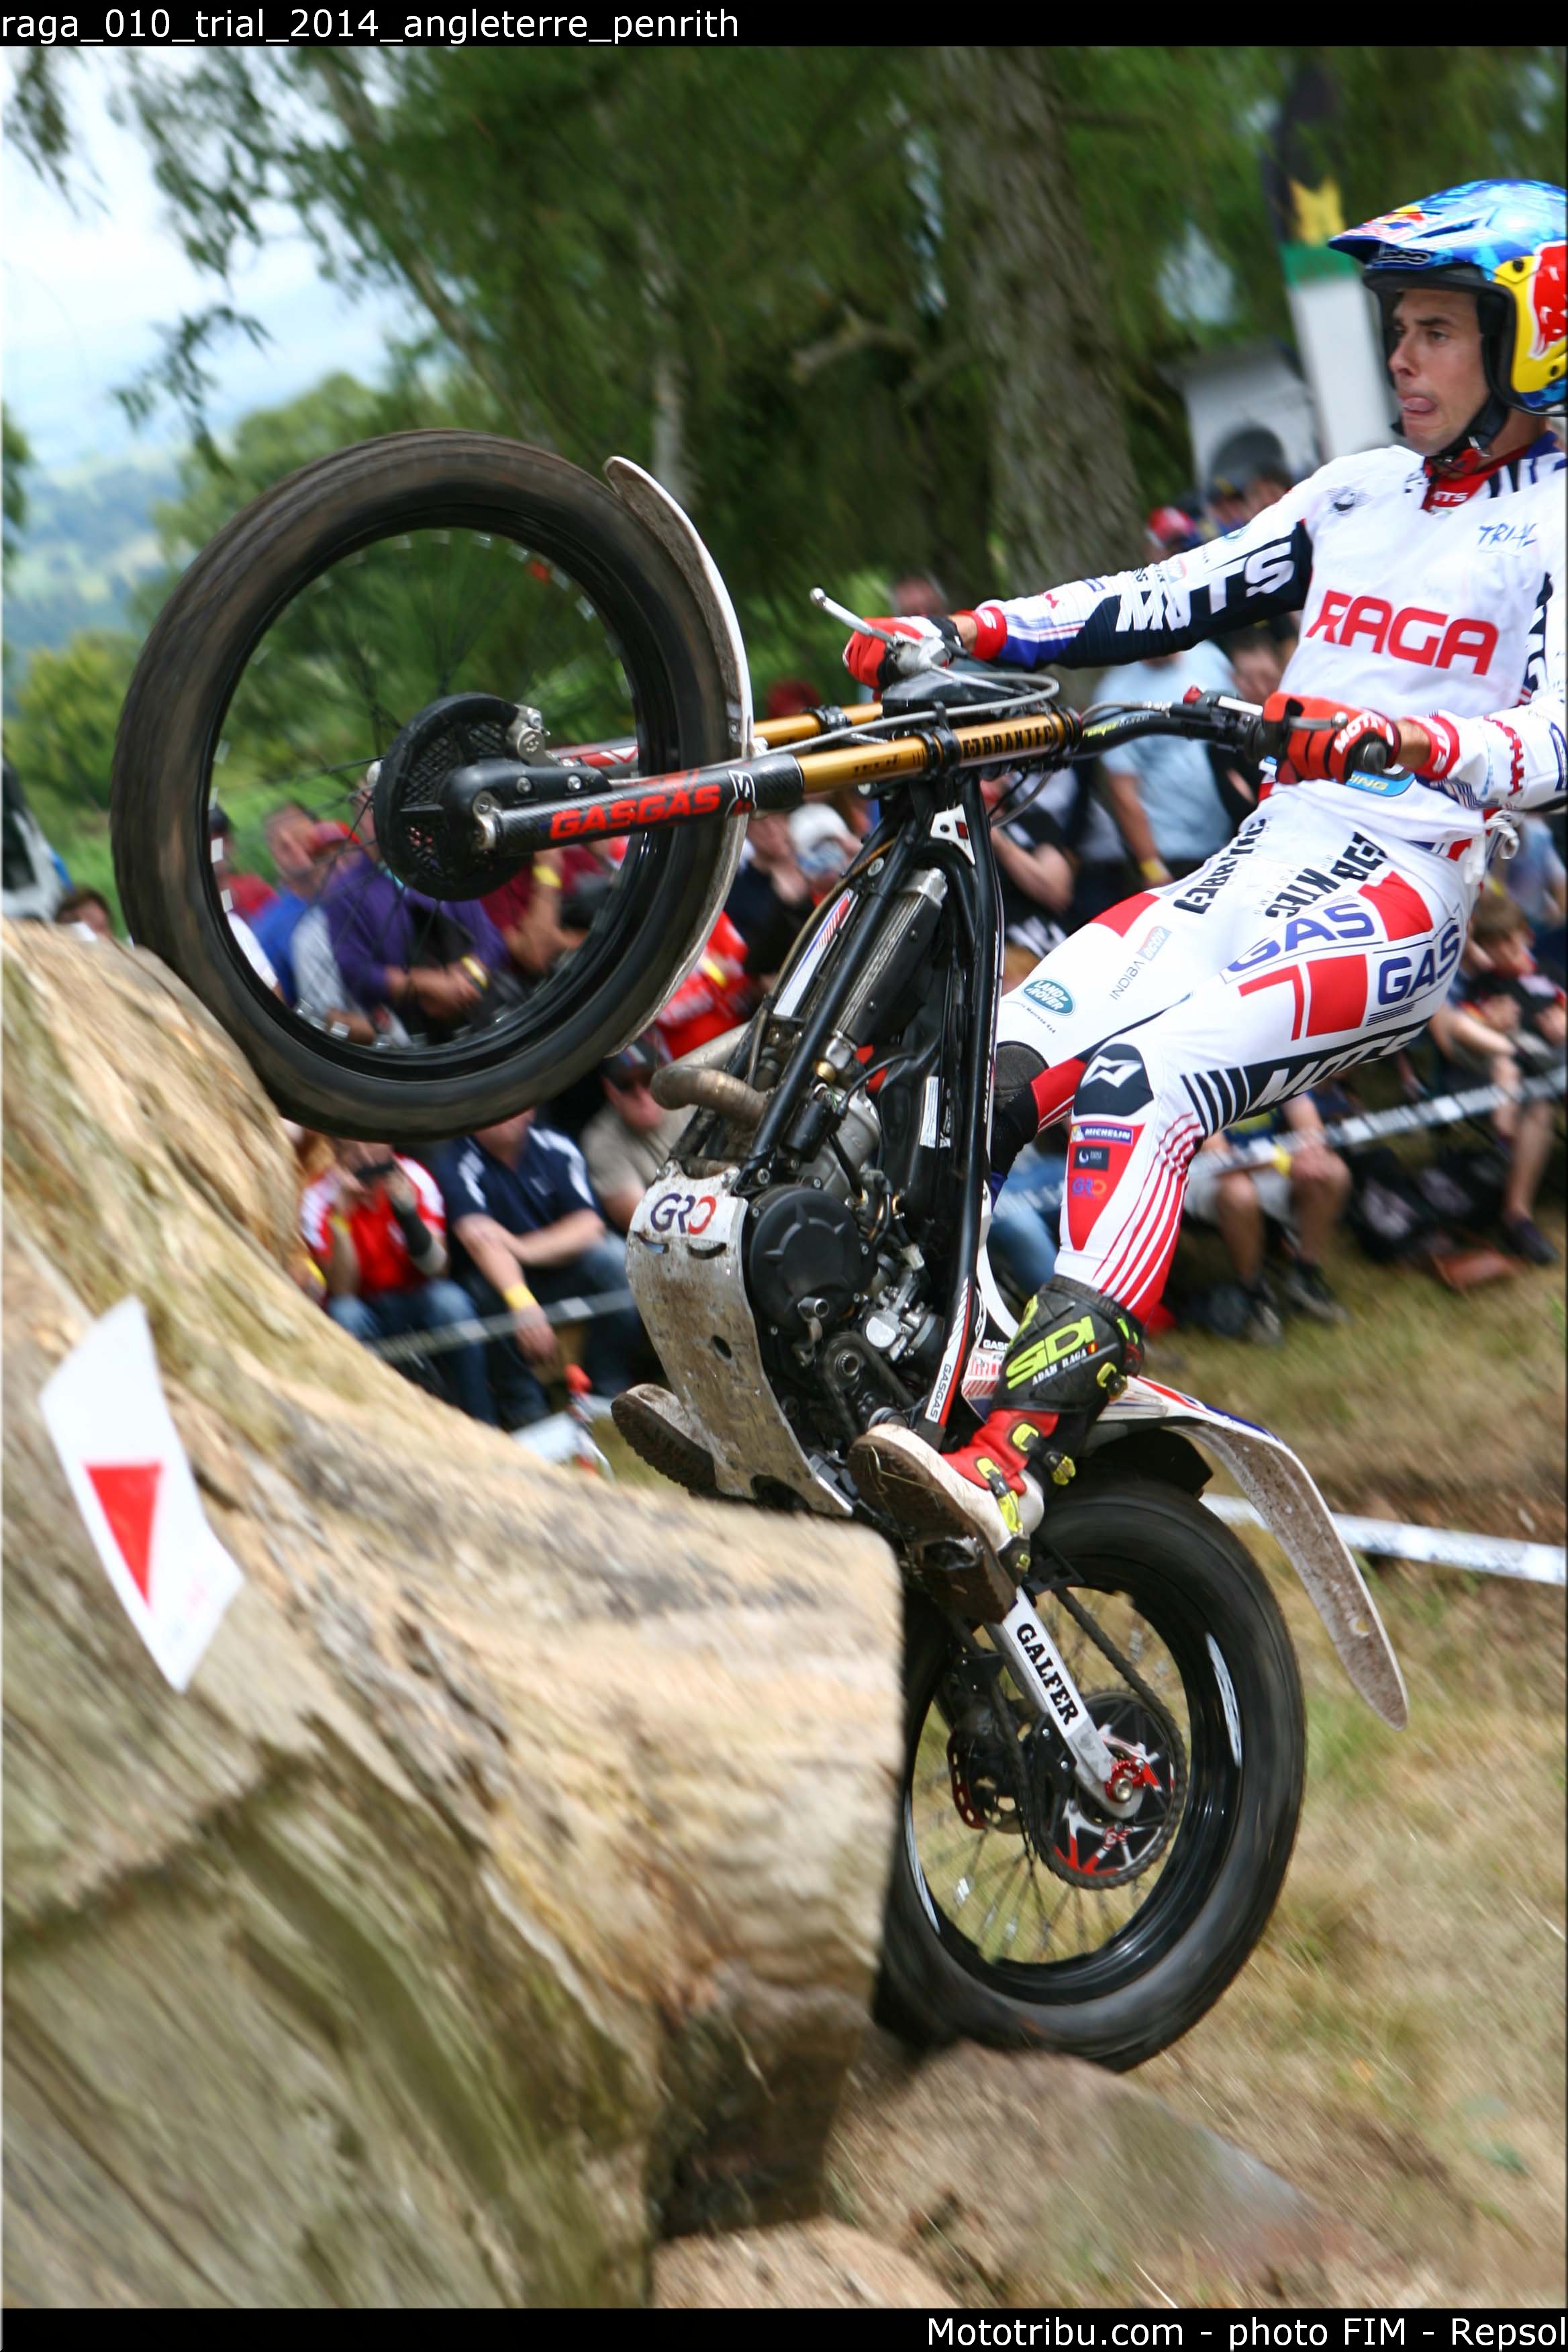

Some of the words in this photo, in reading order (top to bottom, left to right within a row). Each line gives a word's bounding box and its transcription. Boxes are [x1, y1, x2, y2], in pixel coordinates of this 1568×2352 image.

[1305, 589, 1499, 676] RAGA
[549, 783, 722, 840] GASGAS
[1227, 903, 1375, 973] GAS
[1377, 924, 1461, 1006] GAS
[1030, 987, 1065, 1010] ROVER
[1034, 981, 1066, 998] LAND
[1109, 960, 1145, 1001] INDIBA
[1084, 1127, 1131, 1140] MICHELIN
[650, 1192, 717, 1235] GRO
[1006, 1314, 1095, 1391] SIDI
[1032, 1365, 1058, 1387] ADAM
[1061, 1347, 1087, 1369] RAGA
[929, 1363, 952, 1419] GASGAS
[1016, 1622, 1080, 1726] GALFER
